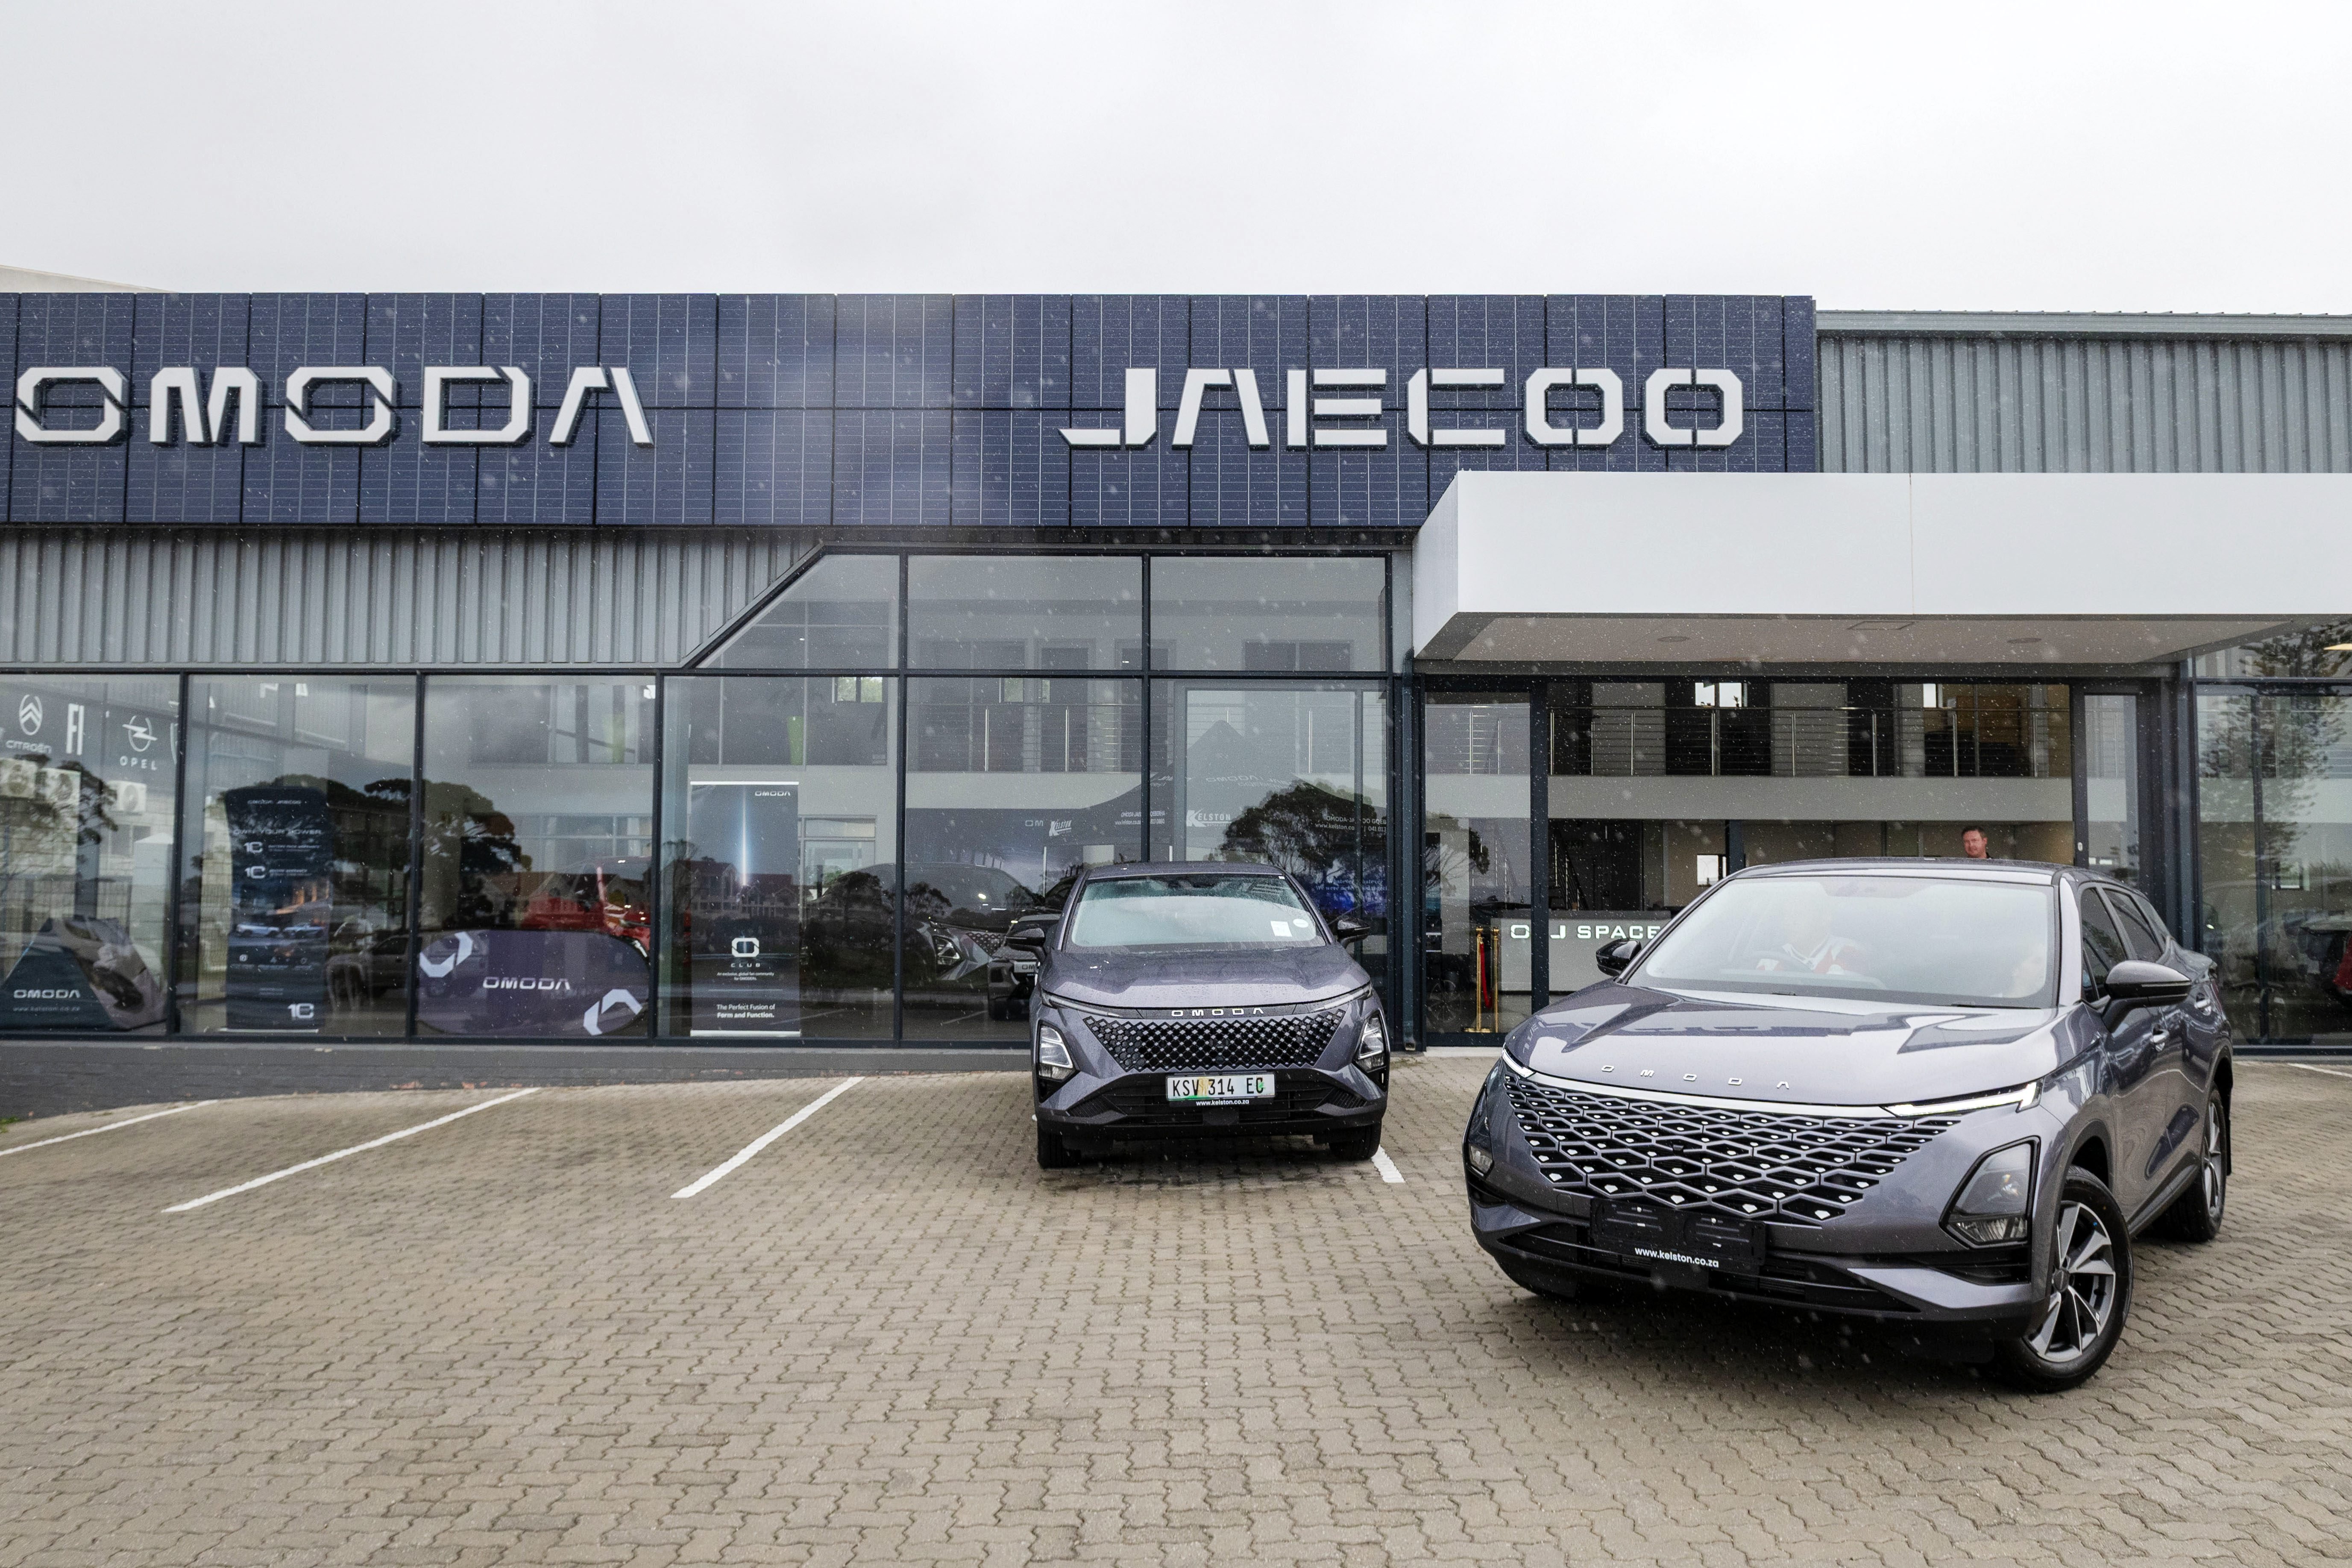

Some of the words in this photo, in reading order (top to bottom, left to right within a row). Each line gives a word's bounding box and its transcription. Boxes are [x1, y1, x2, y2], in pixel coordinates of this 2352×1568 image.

[15, 366, 654, 445] OMODA
[1058, 369, 1744, 448] JAECOO
[120, 756, 157, 771] OPEL
[1186, 809, 1231, 827] KELSTON
[1577, 925, 1661, 939] SPACE
[483, 976, 570, 990] OMODA
[14, 989, 81, 999] OMODA
[1171, 1008, 1264, 1017] OMODA
[1173, 1079, 1199, 1096] KSV
[1208, 1079, 1234, 1096] 314
[1246, 1077, 1264, 1094] EC
[1601, 1065, 1789, 1090] OMODA
[1635, 1247, 1719, 1268] www.kelston.co.za
